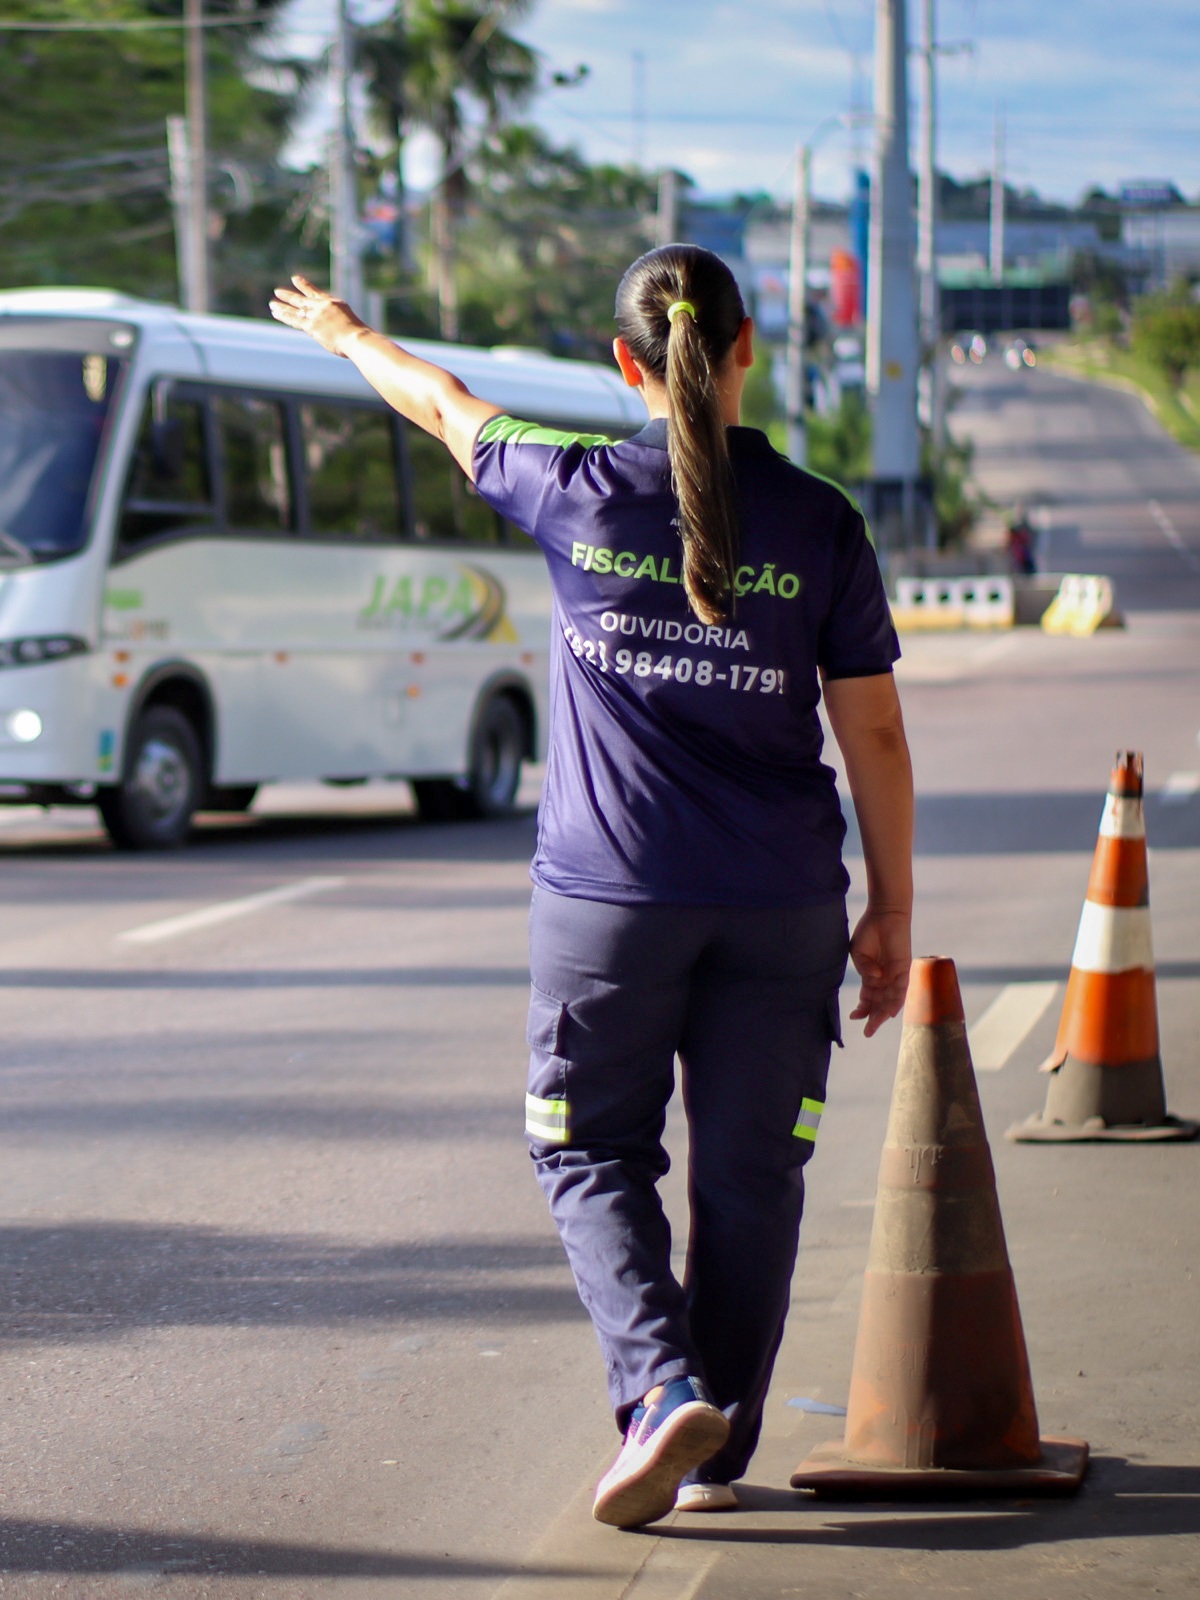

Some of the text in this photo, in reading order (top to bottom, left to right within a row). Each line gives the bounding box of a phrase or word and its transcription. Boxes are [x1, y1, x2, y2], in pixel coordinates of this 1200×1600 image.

[571, 541, 800, 599] FISCALÇÃO
[359, 574, 473, 618] JAPA
[600, 611, 750, 651] OUVIDORIA
